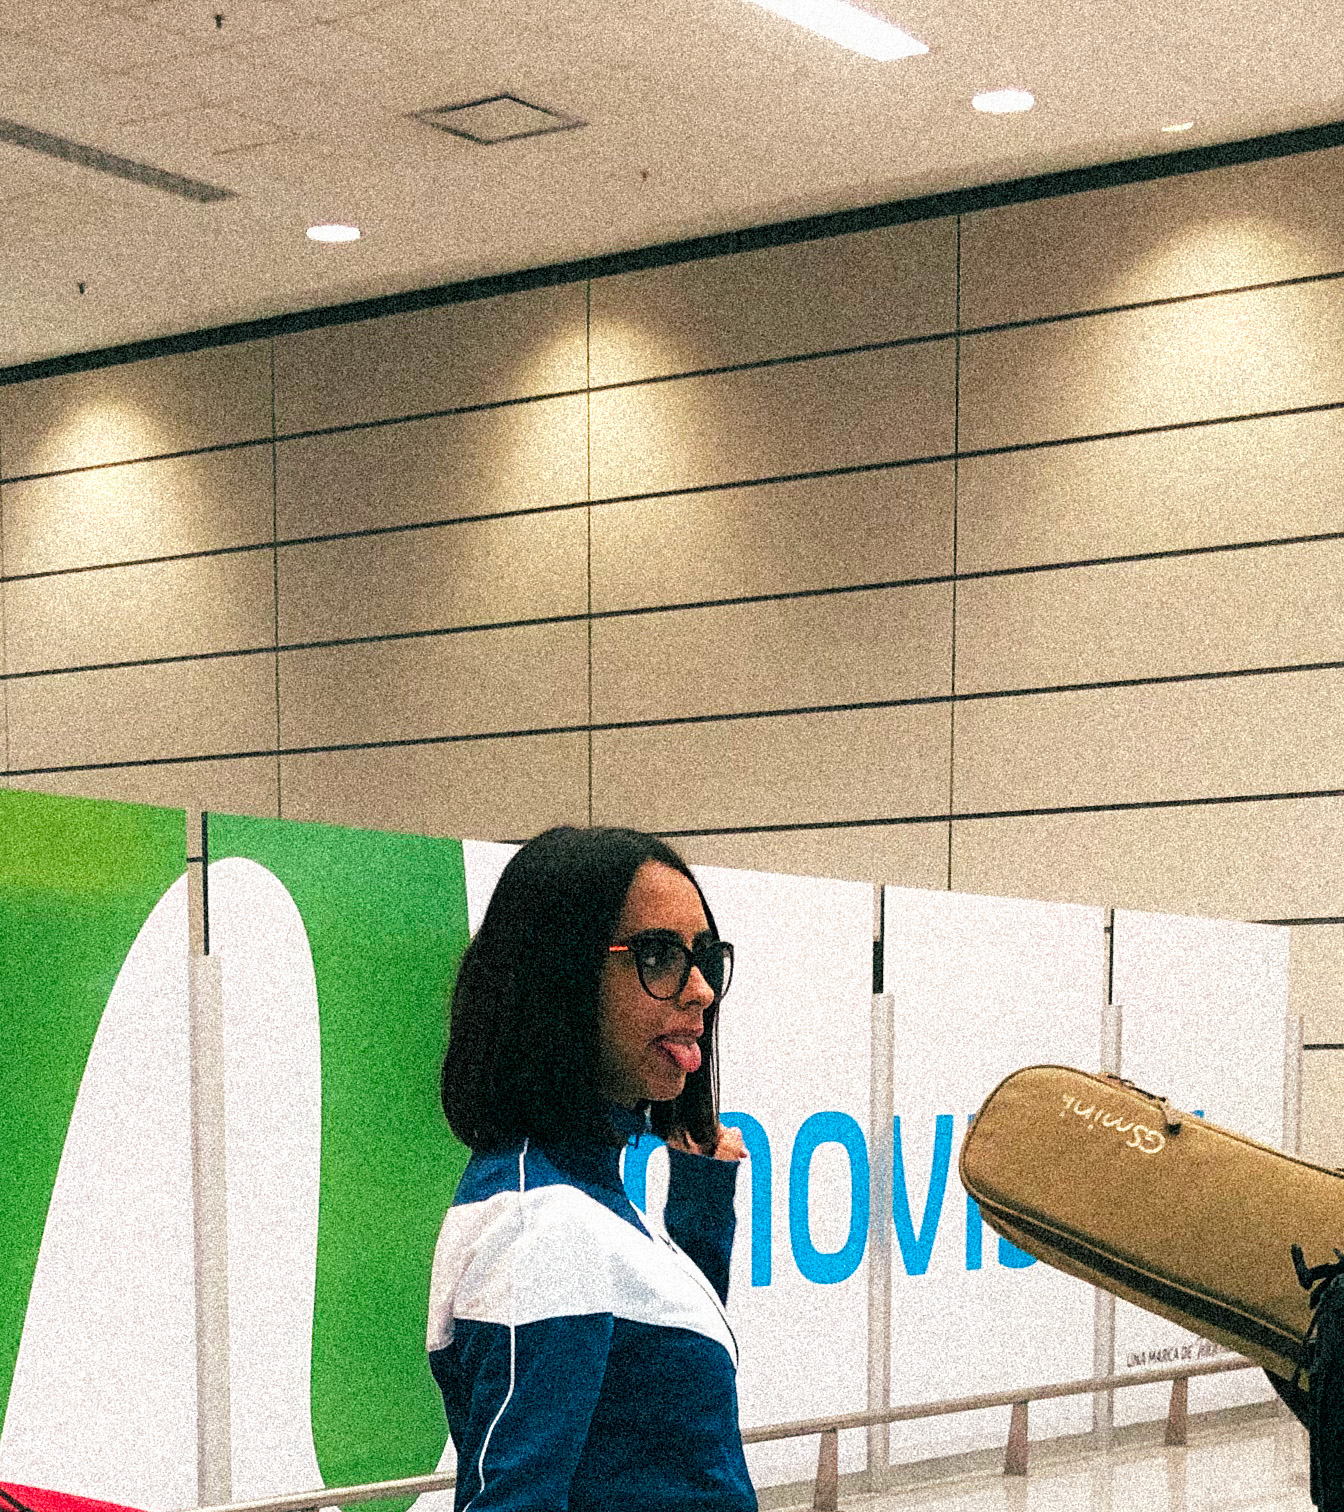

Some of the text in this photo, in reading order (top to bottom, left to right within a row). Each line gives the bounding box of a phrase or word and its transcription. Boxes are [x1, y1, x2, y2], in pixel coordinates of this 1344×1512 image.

[1126, 1351, 1146, 1368] UNA
[1149, 1346, 1179, 1362] MARCA
[1181, 1344, 1193, 1360] DE
